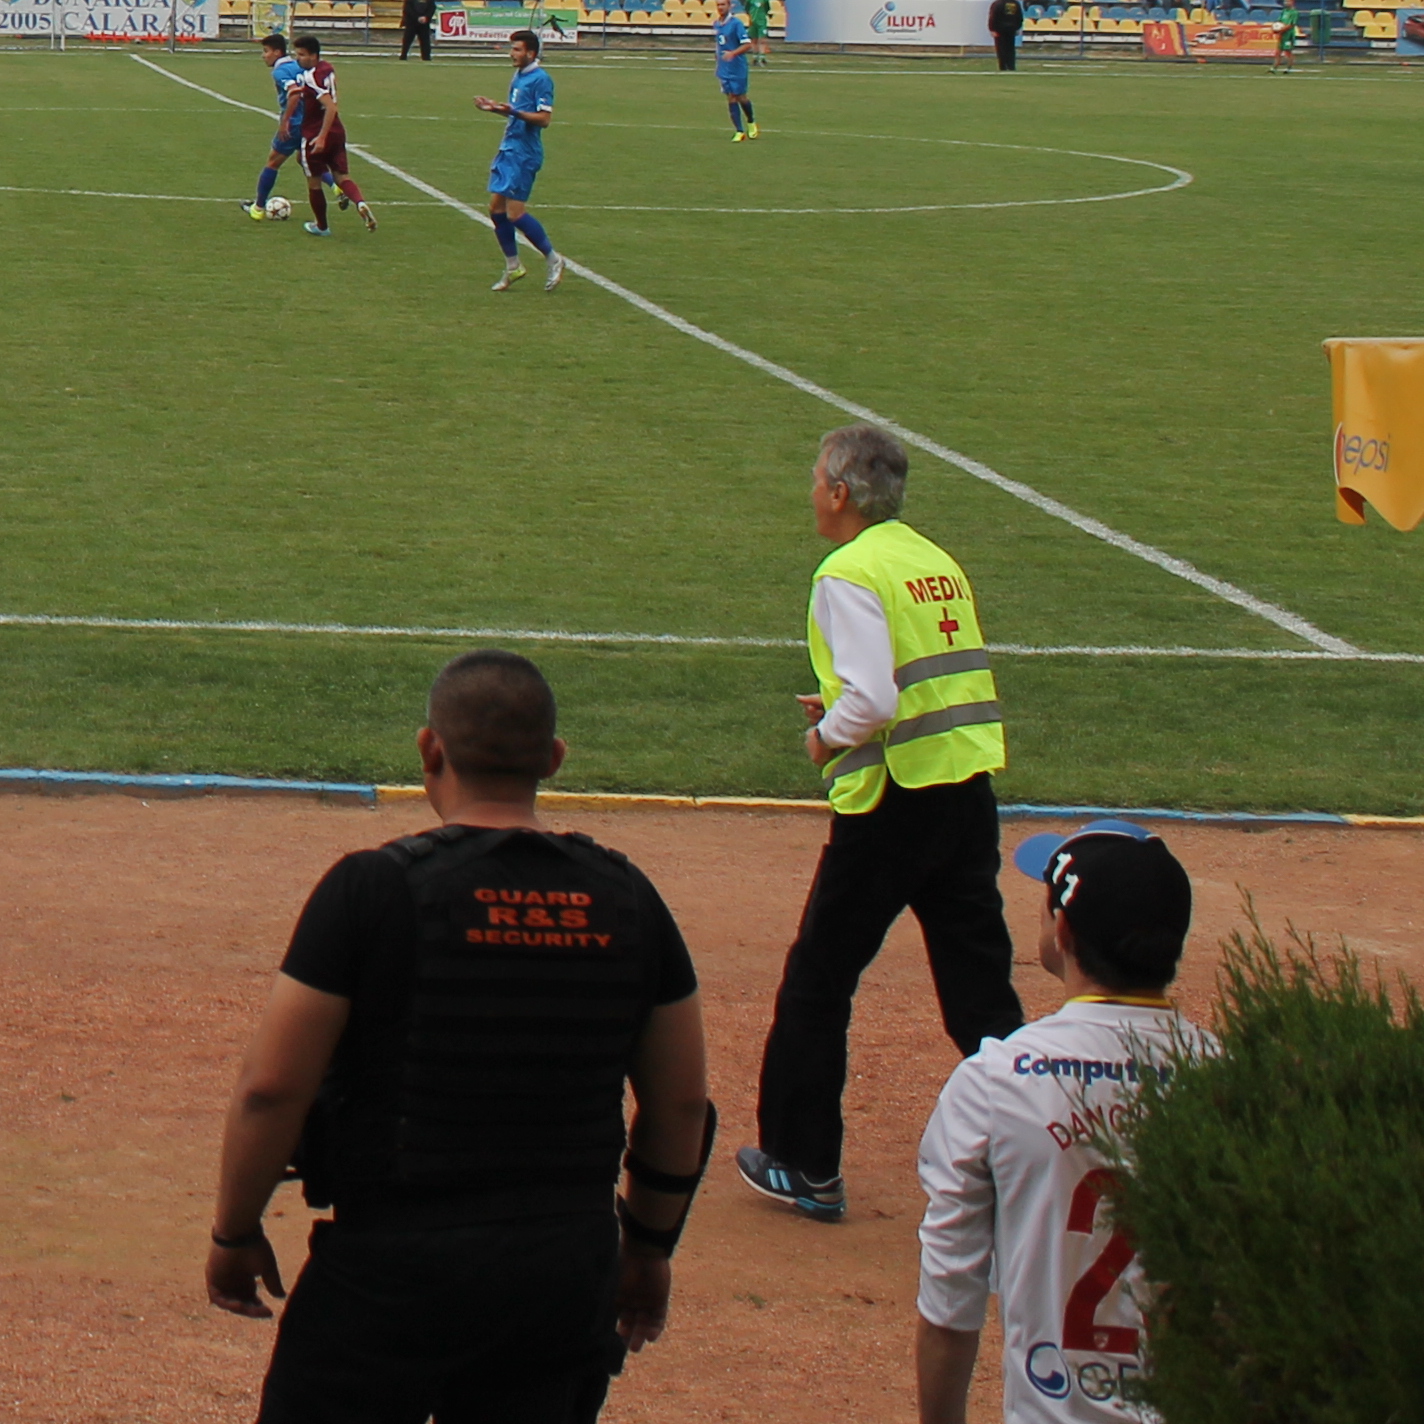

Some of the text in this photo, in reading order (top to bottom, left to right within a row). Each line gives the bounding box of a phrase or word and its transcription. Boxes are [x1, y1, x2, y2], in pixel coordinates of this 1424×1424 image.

[473, 888, 593, 906] GUARD
[488, 906, 590, 929] R&S
[465, 929, 612, 948] SECURITY
[1013, 1053, 1174, 1086] Computr
